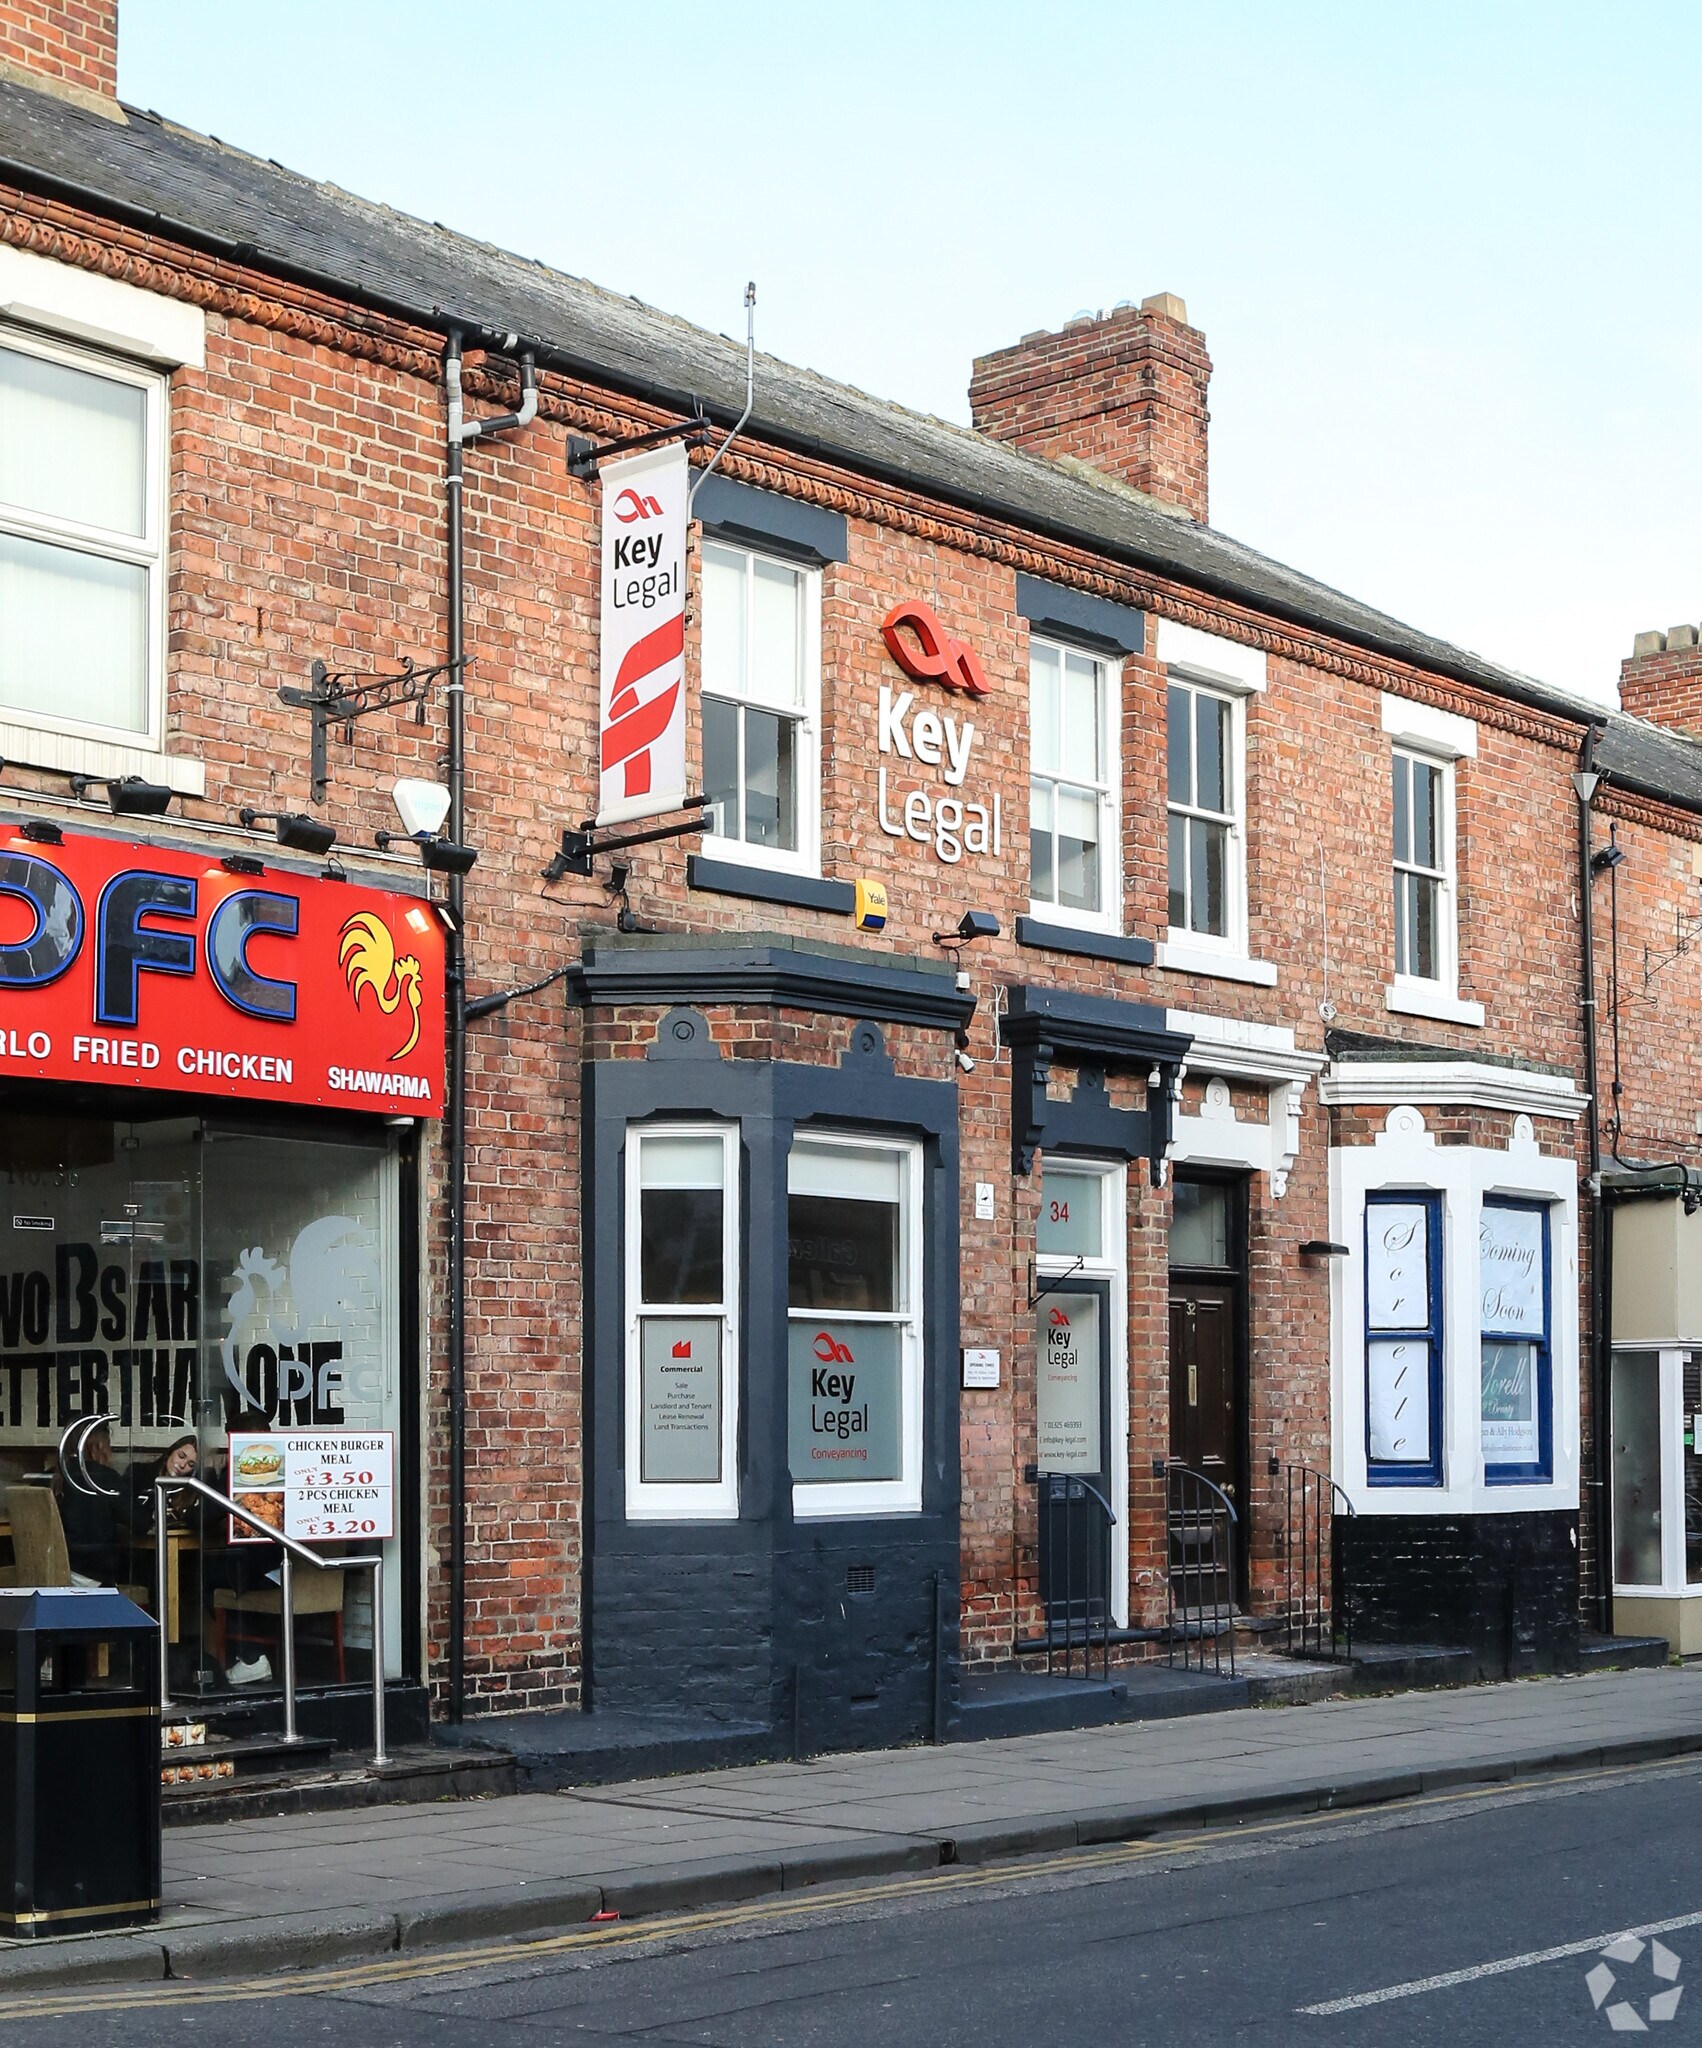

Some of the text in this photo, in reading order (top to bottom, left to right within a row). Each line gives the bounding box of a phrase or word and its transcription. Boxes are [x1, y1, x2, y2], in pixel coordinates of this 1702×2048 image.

[614, 533, 662, 572] Key
[613, 562, 679, 609] Legal
[879, 685, 975, 786] Key
[878, 766, 1001, 864] Legal
[868, 892, 886, 906] Yale
[73, 1036, 160, 1069] FRIED
[177, 1047, 293, 1083] CHICKEN
[328, 1066, 431, 1100] SHAWARMA
[1050, 1201, 1070, 1223] 34
[1186, 1302, 1196, 1315] 32
[1482, 1284, 1526, 1327] Soon
[1048, 1328, 1071, 1349] Key
[1048, 1349, 1078, 1369] Legal
[279, 1360, 380, 1409] DFC
[811, 1368, 856, 1404] Key
[1048, 1374, 1078, 1382] Conveyancing
[811, 1403, 868, 1439] Legal
[287, 1440, 384, 1451] CHICKEN BURGER
[811, 1447, 867, 1461] Conveyancing
[320, 1454, 352, 1465] MEAL
[293, 1467, 318, 1475] ONLY
[304, 1471, 373, 1486] £3.50
[299, 1489, 379, 1500] 2 PCS CHICKEN
[323, 1503, 355, 1513] MEAL
[296, 1516, 320, 1525] ONLY
[307, 1519, 376, 1535] £3.20
